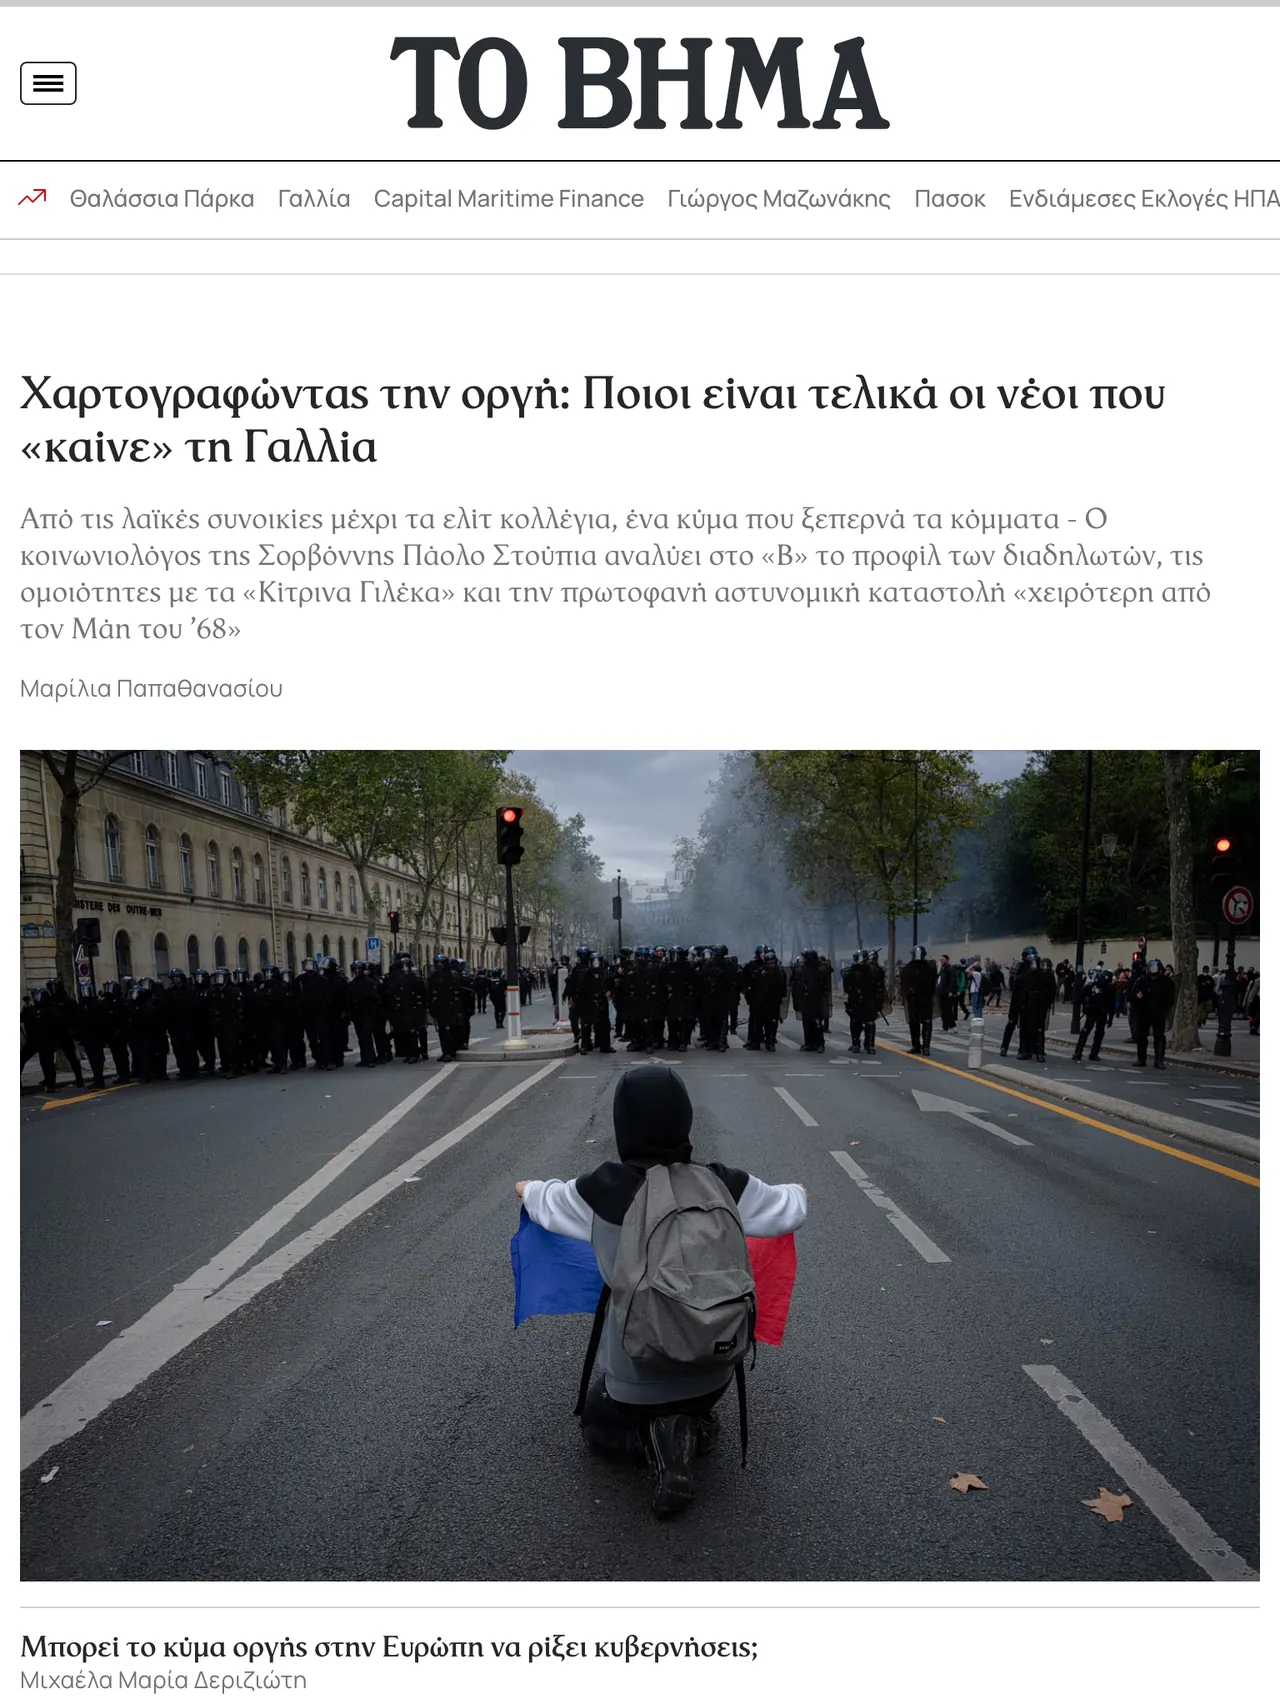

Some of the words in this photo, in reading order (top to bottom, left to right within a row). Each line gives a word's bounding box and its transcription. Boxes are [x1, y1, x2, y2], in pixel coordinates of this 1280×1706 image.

[71, 188, 177, 207] Θαλάσσια
[185, 188, 253, 212] Πάρκα
[280, 188, 349, 207] Γαλλία
[375, 189, 451, 212] Capital
[459, 190, 553, 207] Maritime
[560, 189, 643, 207] Finance
[669, 188, 757, 212] Γιώργος
[764, 188, 890, 210] Μαζωνάκης
[916, 190, 986, 207] Πασοκ
[1011, 188, 1135, 212] Ενδιάμεσες
[1143, 188, 1228, 211] Εκλογές
[1235, 190, 1280, 207] ΗΠΑ
[20, 376, 368, 418] Χαρτογραφώντας
[380, 386, 450, 409] την
[462, 378, 569, 418] οργή:
[584, 376, 691, 409] Ποιοι
[703, 378, 797, 409] είναι
[808, 374, 938, 409] τελικά
[950, 386, 986, 409] οι
[997, 378, 1078, 409] νέοι
[1090, 386, 1165, 409] που
[22, 431, 172, 462] «καίνε»
[185, 439, 232, 462] τη
[245, 428, 377, 462] Γαλλία
[20, 508, 72, 529] Από
[81, 514, 113, 529] τις
[122, 507, 199, 529] λαϊκές
[208, 509, 322, 529] συνοικίες
[332, 509, 397, 534] μέχρι
[405, 514, 435, 529] τα
[444, 507, 491, 529] ελίτ
[501, 507, 617, 534] κολλέγια,
[626, 509, 668, 529] ένα
[678, 509, 738, 534] κύμα
[746, 514, 793, 529] που
[802, 507, 905, 534] ξεπερνά
[913, 514, 942, 529] τα
[951, 509, 1059, 534] κόμματα
[1086, 507, 1107, 529] Ο
[21, 543, 200, 571] κοινωνιολόγος
[208, 551, 250, 565] της
[259, 543, 394, 571] Σορβόννης
[404, 543, 484, 565] Πάολο
[493, 544, 596, 565] Στούπια
[605, 543, 701, 565] αναλύει
[710, 551, 753, 565] στο
[763, 544, 807, 565] «Β»
[816, 551, 844, 565] το
[852, 543, 941, 571] προφίλ
[948, 551, 995, 565] των
[1004, 543, 1161, 569] διαδηλωτών,
[1170, 551, 1203, 565] τις
[20, 624, 64, 639] τον
[73, 618, 130, 639] Μάη
[139, 624, 182, 639] του
[191, 617, 240, 639] ’68»
[22, 678, 110, 702] Μαρίλια
[118, 678, 282, 697] Παπαθανασίου
[108, 902, 121, 913] DES
[21, 1635, 119, 1663] Μπορεί
[126, 1642, 156, 1657] το
[164, 1637, 226, 1663] κύμα
[233, 1637, 307, 1663] οργής
[315, 1642, 375, 1657] στην
[383, 1636, 484, 1663] Ευρώπη
[491, 1642, 521, 1657] να
[529, 1634, 587, 1663] ρίξει
[595, 1635, 757, 1663] κυβερνήσεις;
[22, 1670, 111, 1689] Μιχαέλα
[120, 1670, 187, 1694] Μαρία
[194, 1670, 306, 1694] Δεριζιώτη
